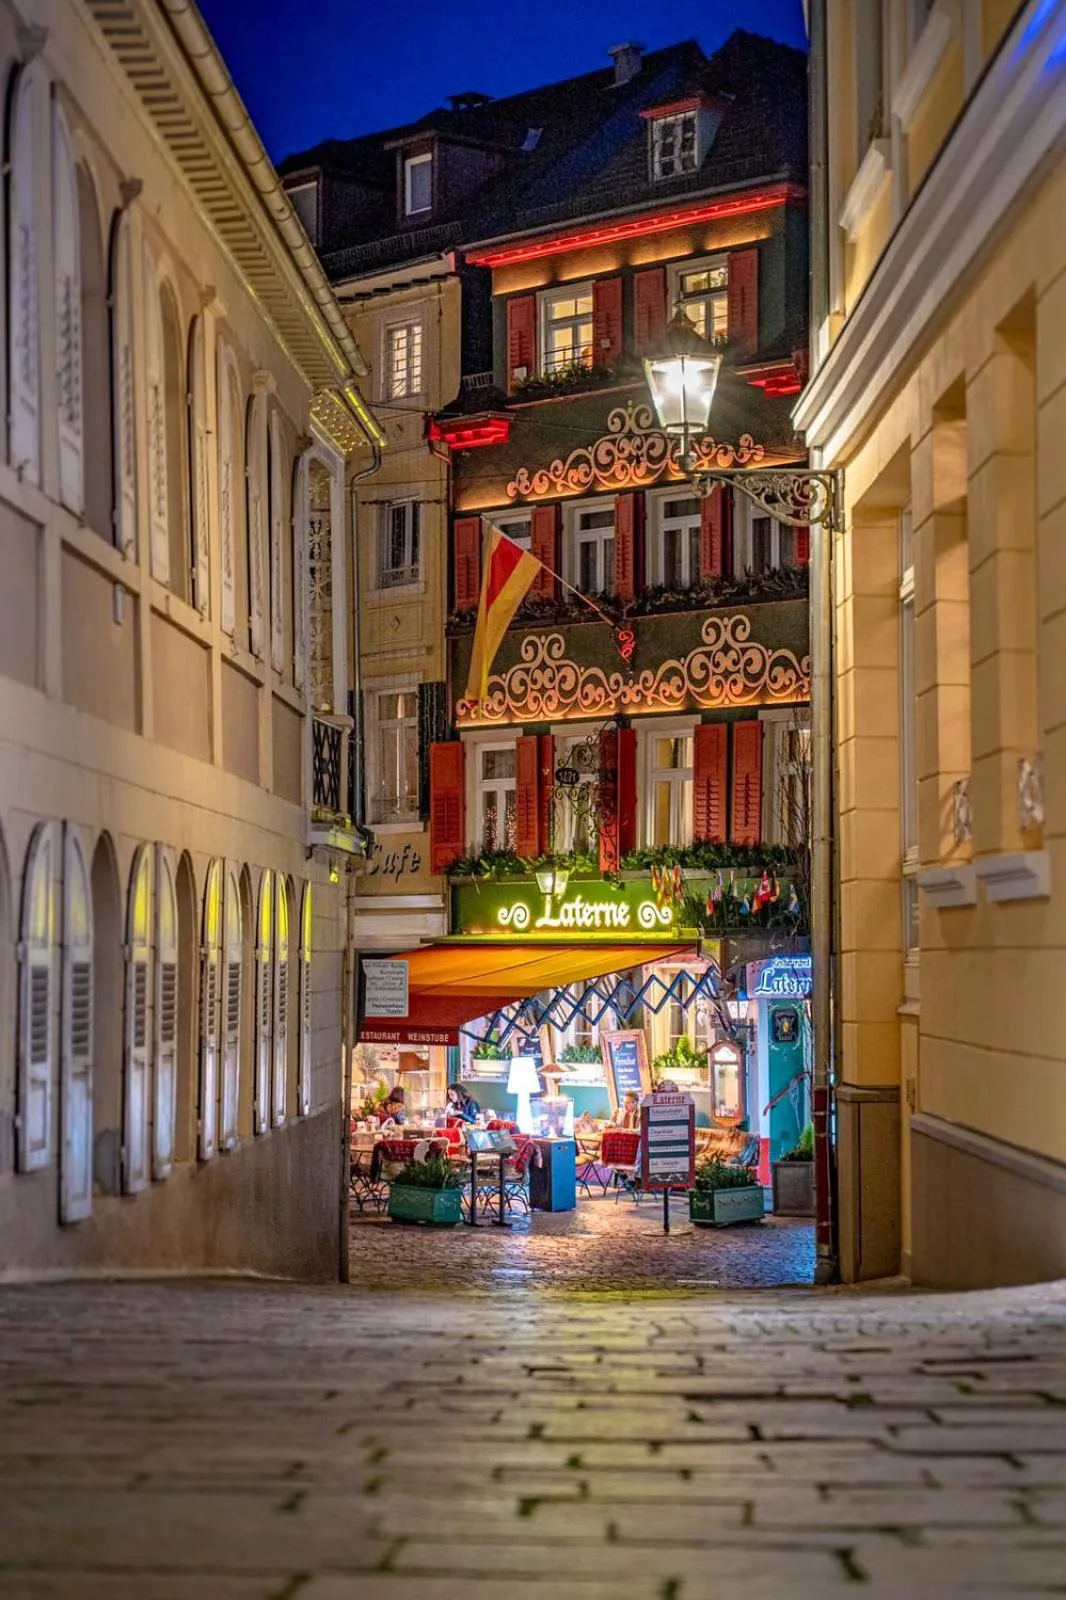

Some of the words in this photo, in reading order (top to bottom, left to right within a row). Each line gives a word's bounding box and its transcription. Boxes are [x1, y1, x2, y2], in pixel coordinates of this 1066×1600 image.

[535, 894, 631, 927] Laterne
[754, 966, 813, 996] Latern
[360, 1031, 400, 1041] ESTAURANT
[407, 1032, 449, 1042] WEINSTUBE
[652, 1094, 686, 1105] Laterne
